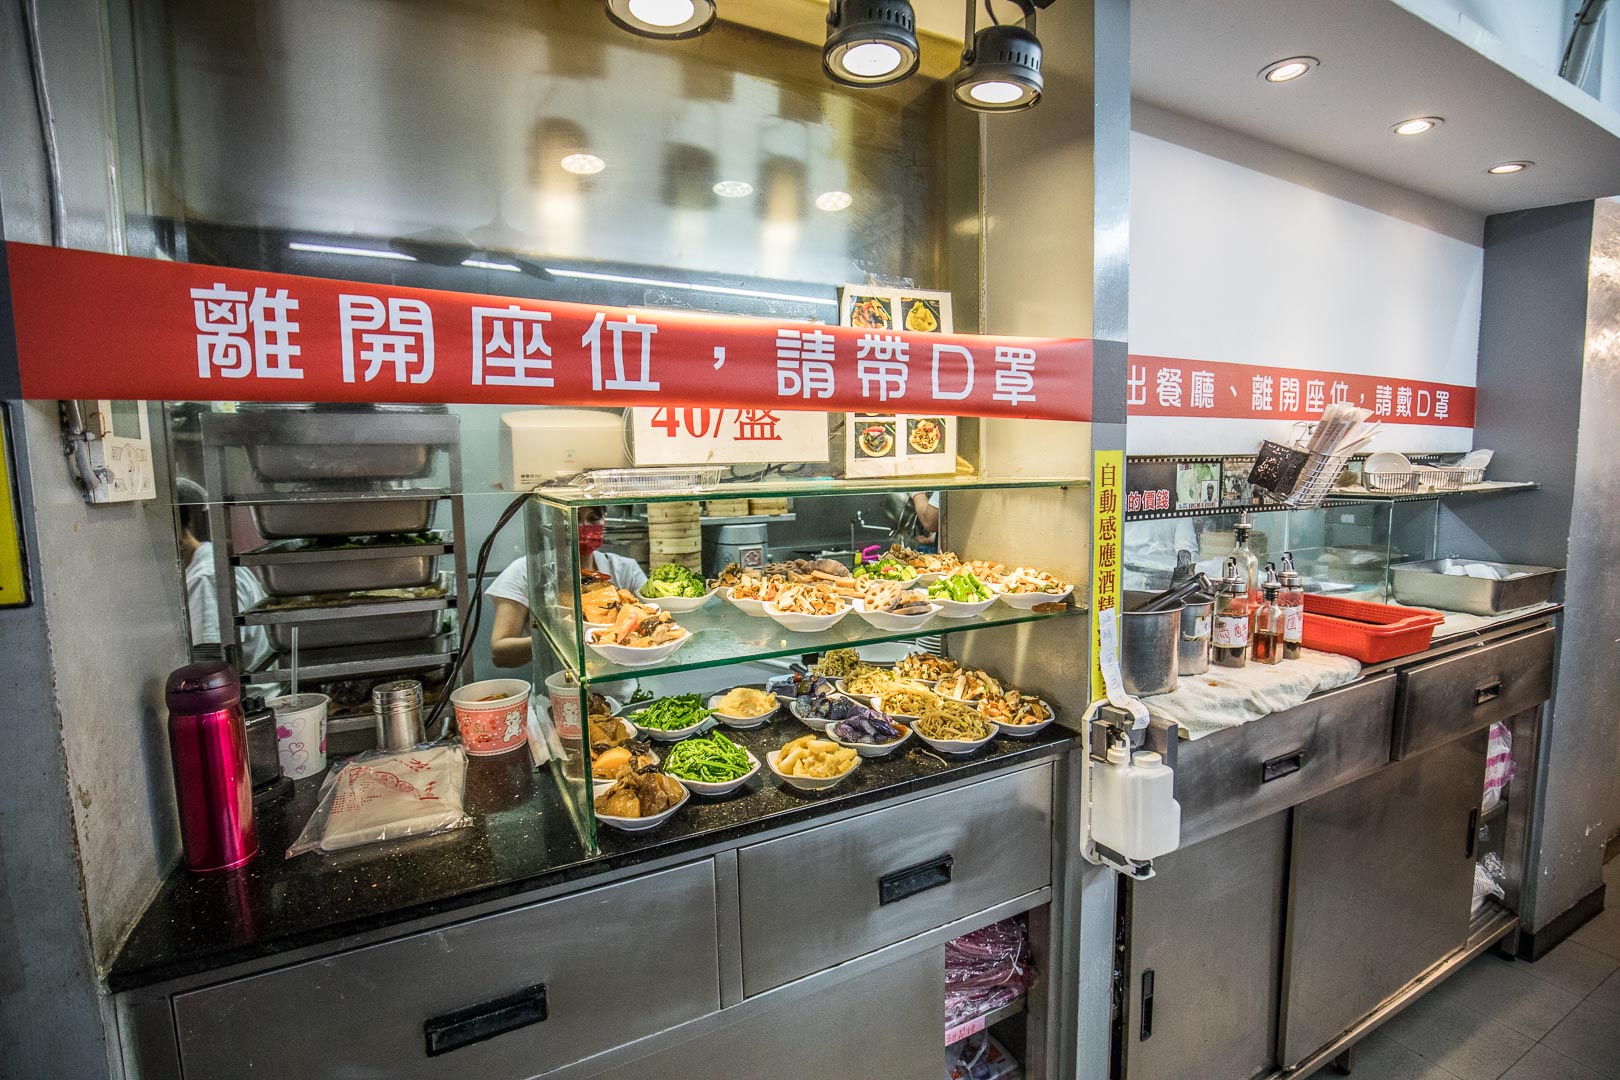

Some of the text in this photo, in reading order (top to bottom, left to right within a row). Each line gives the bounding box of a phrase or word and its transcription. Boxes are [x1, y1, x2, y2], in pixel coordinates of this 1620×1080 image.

[1125, 489, 1170, 513] 的價錢
[1097, 462, 1117, 672] 自動感應酒精
